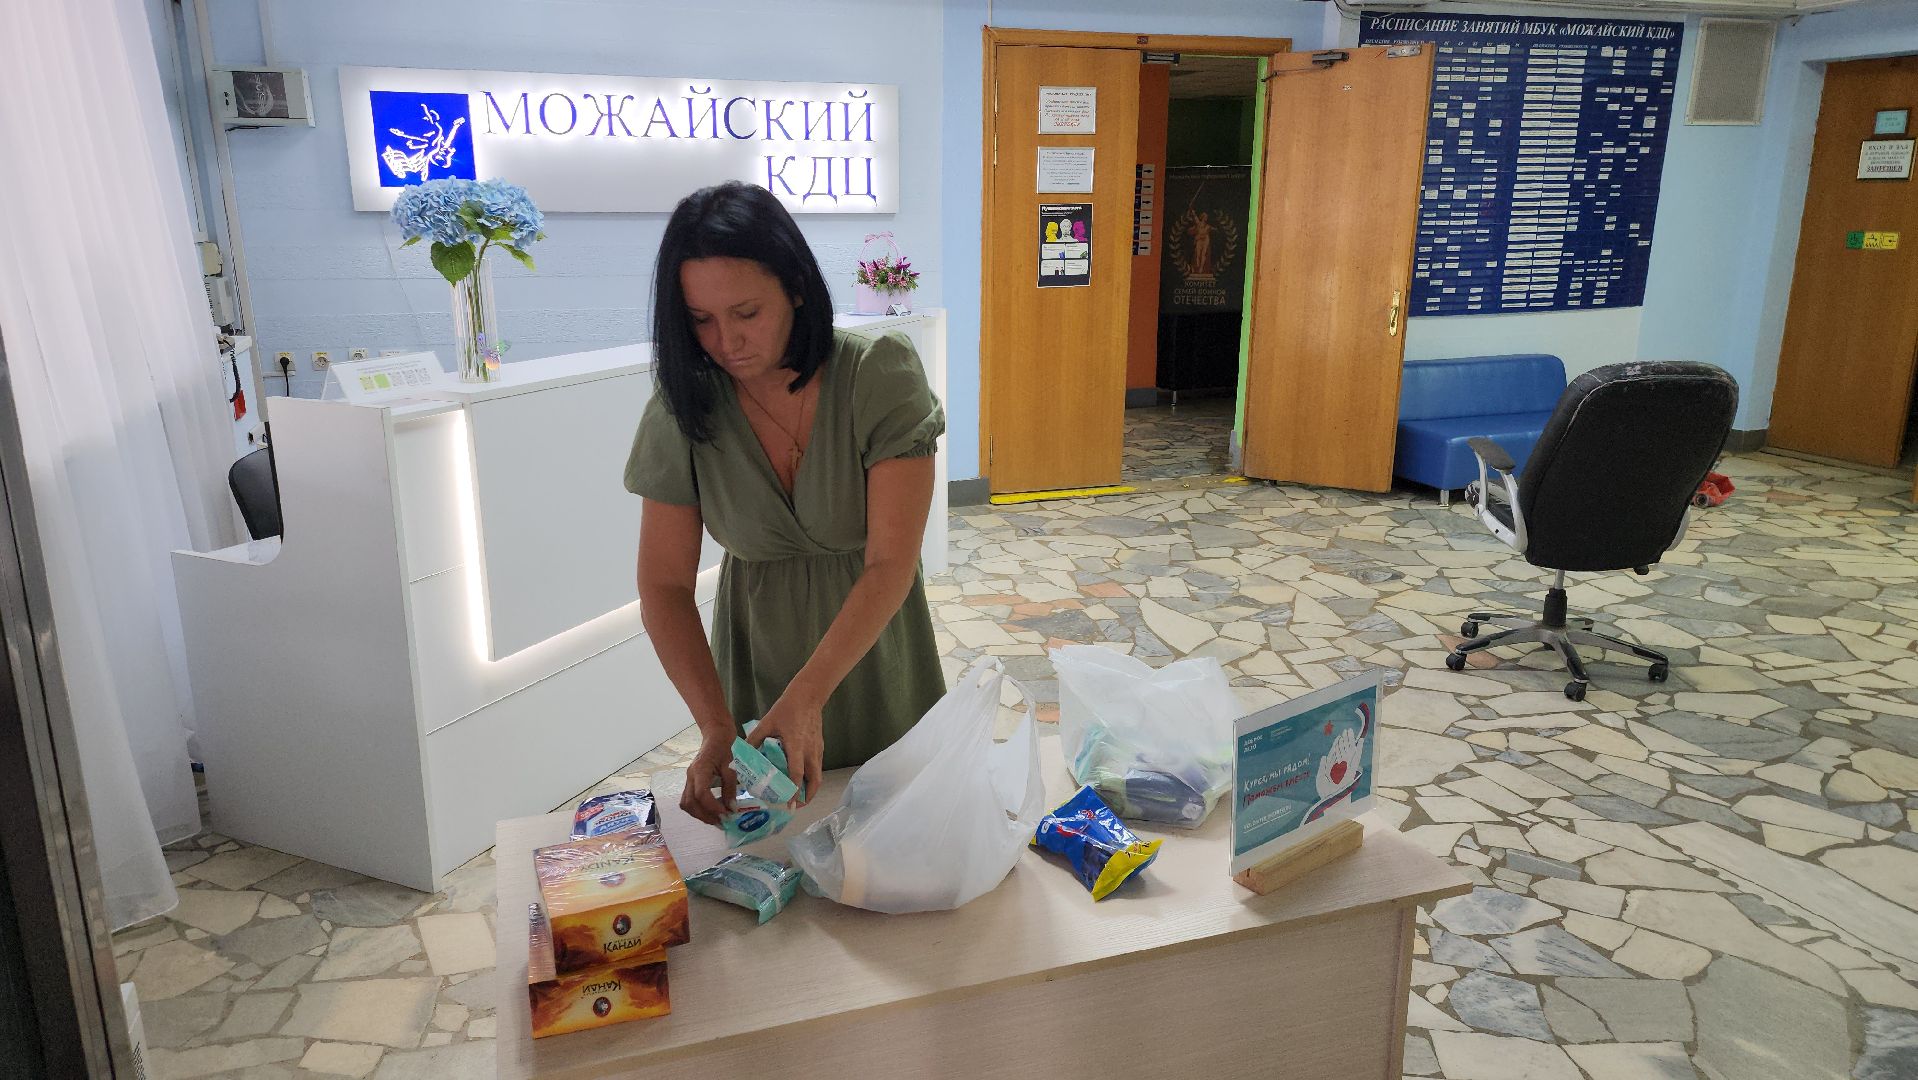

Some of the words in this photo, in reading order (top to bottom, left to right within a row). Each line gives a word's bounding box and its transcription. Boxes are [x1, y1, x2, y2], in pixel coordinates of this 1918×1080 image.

[1369, 17, 1459, 33] РАСПИСАНИЕ
[1460, 19, 1521, 35] ЗАНЯТИЙ
[1521, 22, 1557, 36] МБУК
[1559, 22, 1645, 39] «МОЖАЙСКИЙ
[482, 86, 878, 143] МОЖАЙСКИЙ
[765, 154, 878, 207] КДЦ
[1173, 295, 1226, 305] ОТЕЧЕСТВА
